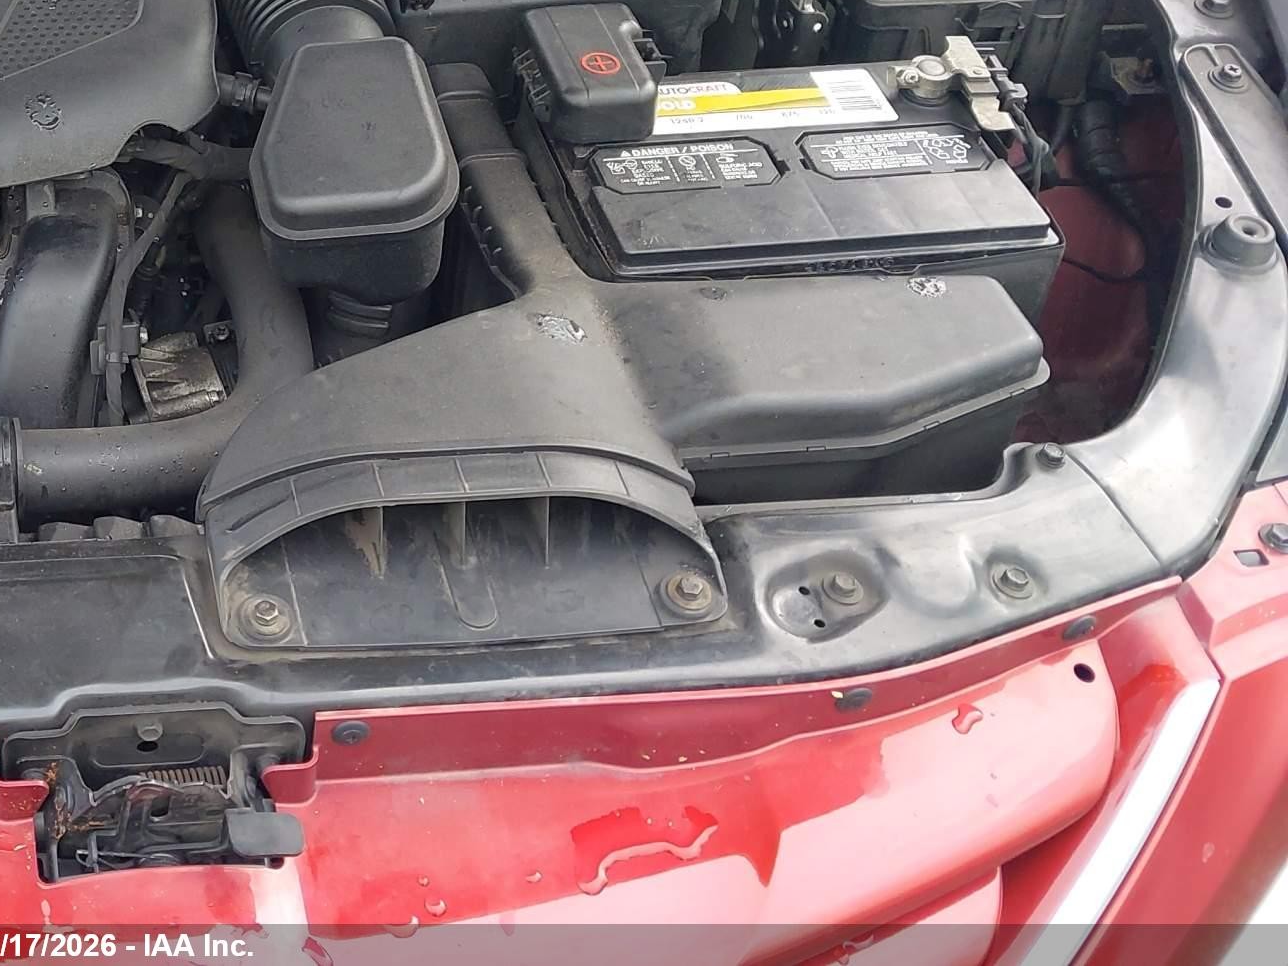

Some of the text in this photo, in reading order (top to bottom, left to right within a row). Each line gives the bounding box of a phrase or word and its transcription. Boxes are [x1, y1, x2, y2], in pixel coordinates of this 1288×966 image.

[658, 99, 697, 111] OLD
[632, 147, 680, 157] DANGER
[690, 143, 734, 152] POISON
